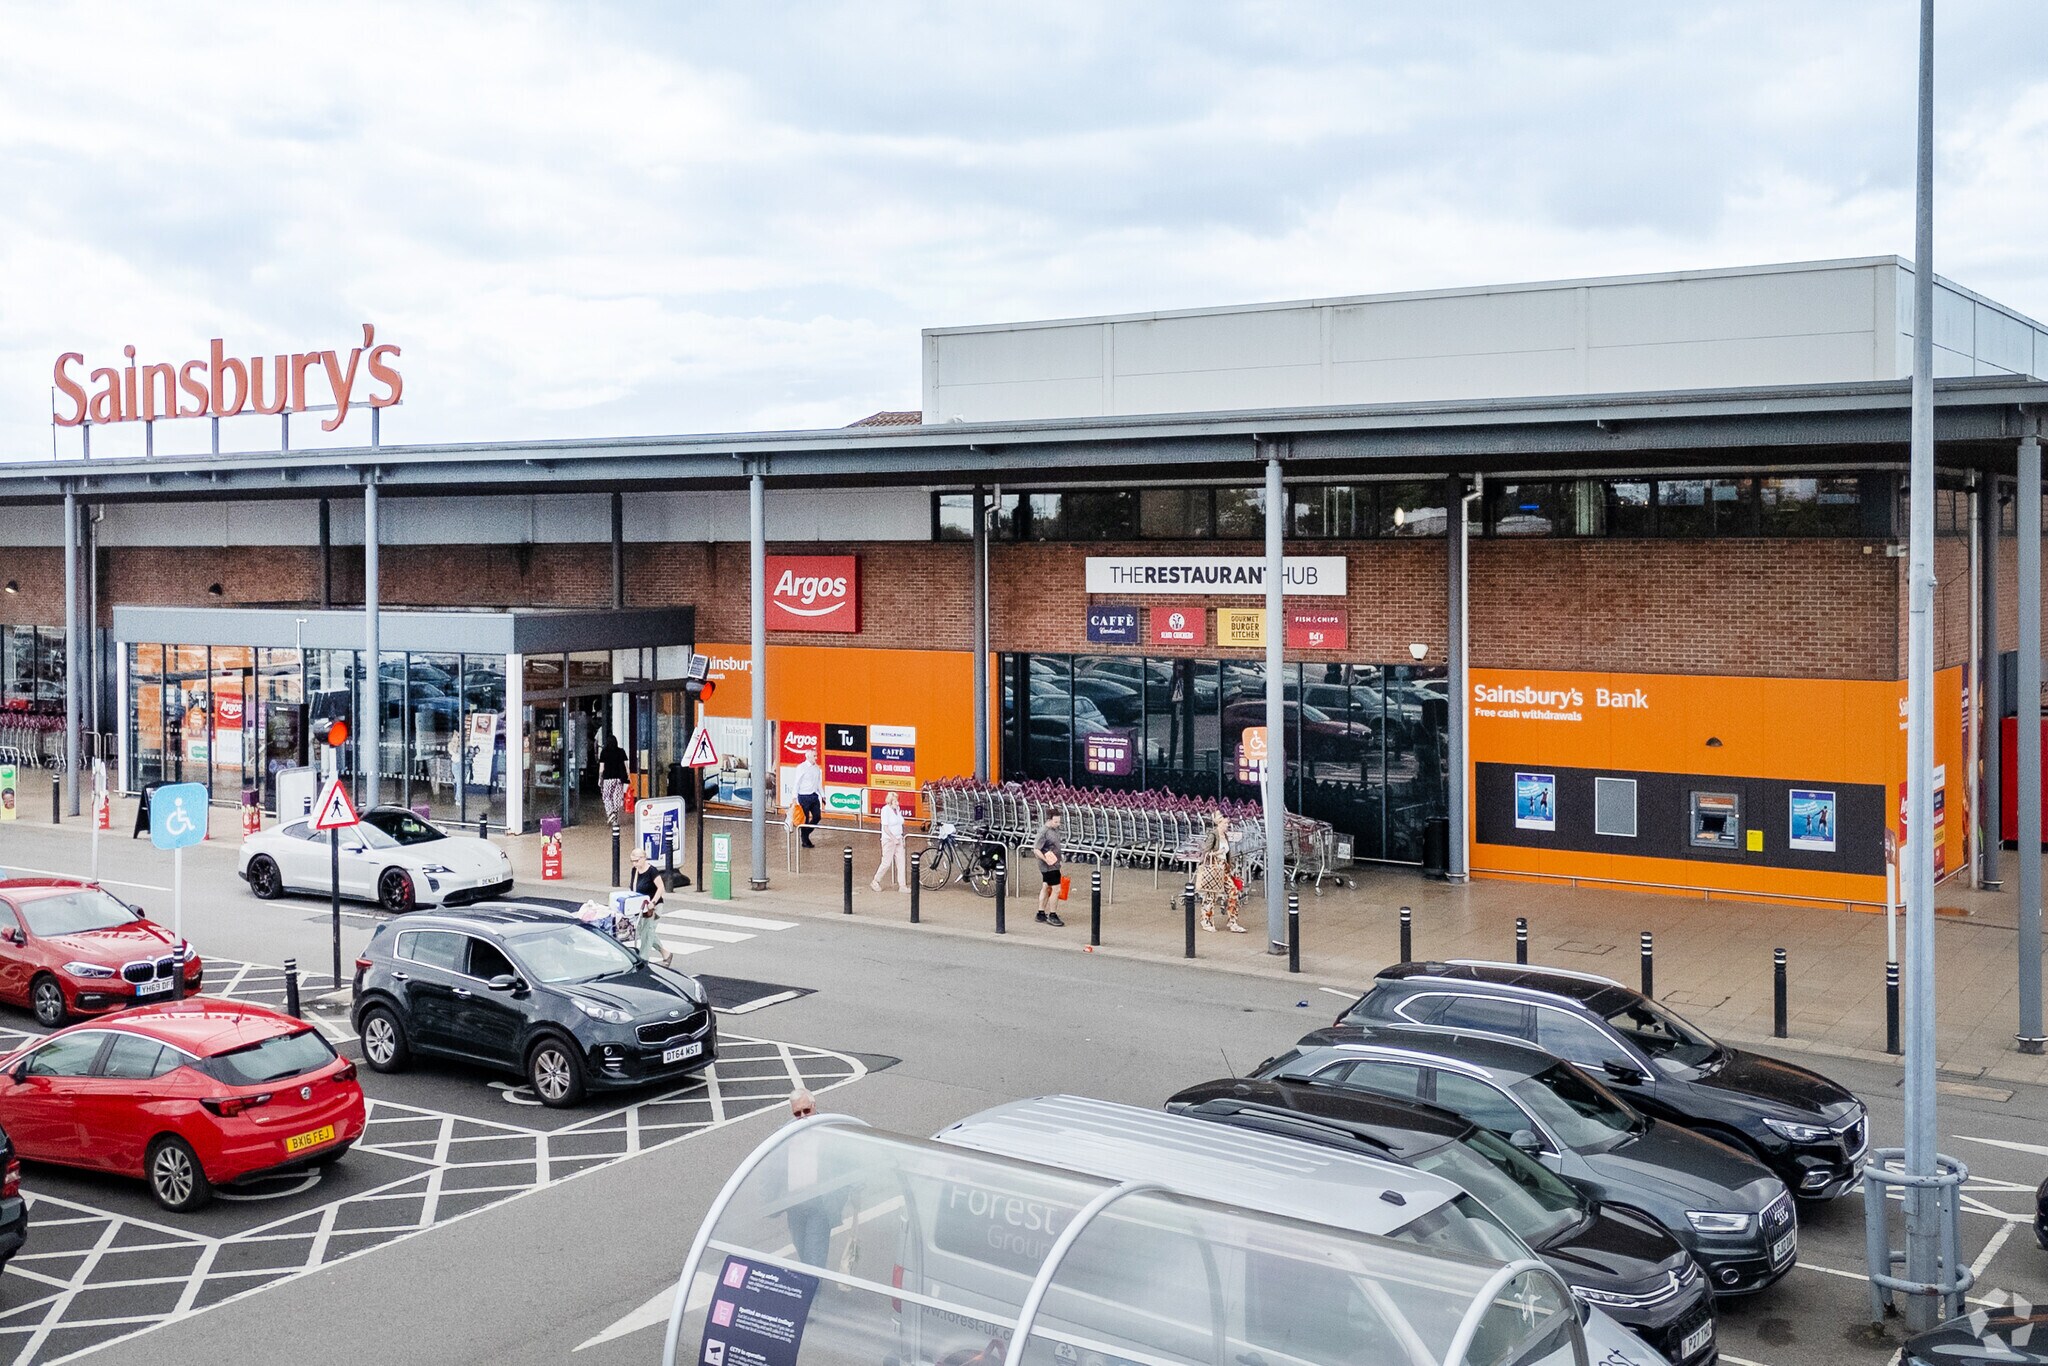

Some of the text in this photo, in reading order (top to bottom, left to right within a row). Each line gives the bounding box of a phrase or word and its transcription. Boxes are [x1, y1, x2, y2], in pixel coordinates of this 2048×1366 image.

[53, 323, 403, 432] Sainsbury's
[773, 569, 847, 605] Argos
[1090, 613, 1134, 626] CAFFÈ
[1230, 622, 1260, 631] BURGER
[1230, 630, 1260, 638] KITCHEN
[1474, 684, 1649, 709] Sainsbury's Bank
[1474, 708, 1582, 722] Free cash withdrawals
[784, 731, 818, 748] Argos
[838, 730, 854, 746] Tu
[828, 764, 864, 774] TIMPSON
[142, 984, 160, 994] YH69
[666, 1048, 684, 1060] DT64
[950, 1186, 1059, 1236] Forest
[730, 1346, 740, 1354] CCTV
